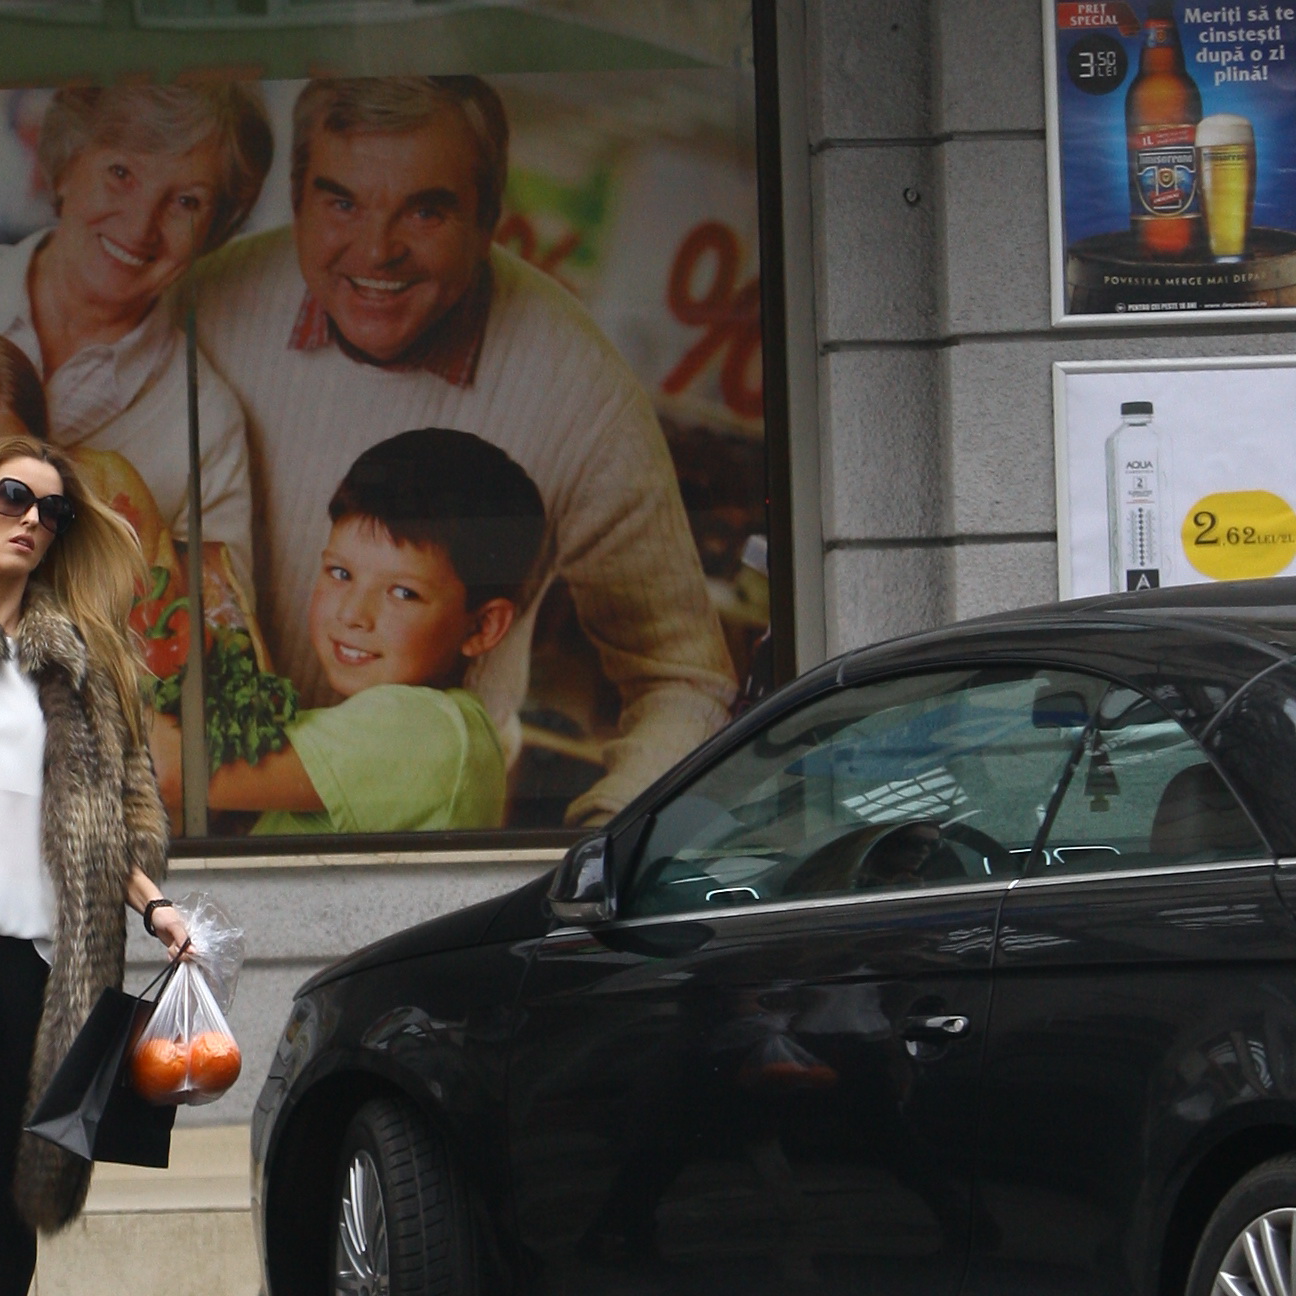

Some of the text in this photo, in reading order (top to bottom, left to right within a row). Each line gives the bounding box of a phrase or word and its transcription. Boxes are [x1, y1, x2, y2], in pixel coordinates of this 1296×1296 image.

[1070, 15, 1118, 26] SPECIAL
[1184, 5, 1295, 26] Meriți să te
[1199, 25, 1282, 45] cinstești
[1195, 45, 1285, 66] după o zi
[1214, 65, 1268, 87] plină!
[1104, 275, 1161, 287] POVESTEA
[1165, 275, 1202, 286] MERGE
[1207, 275, 1229, 286] MAI
[1126, 460, 1153, 469] AQUA
